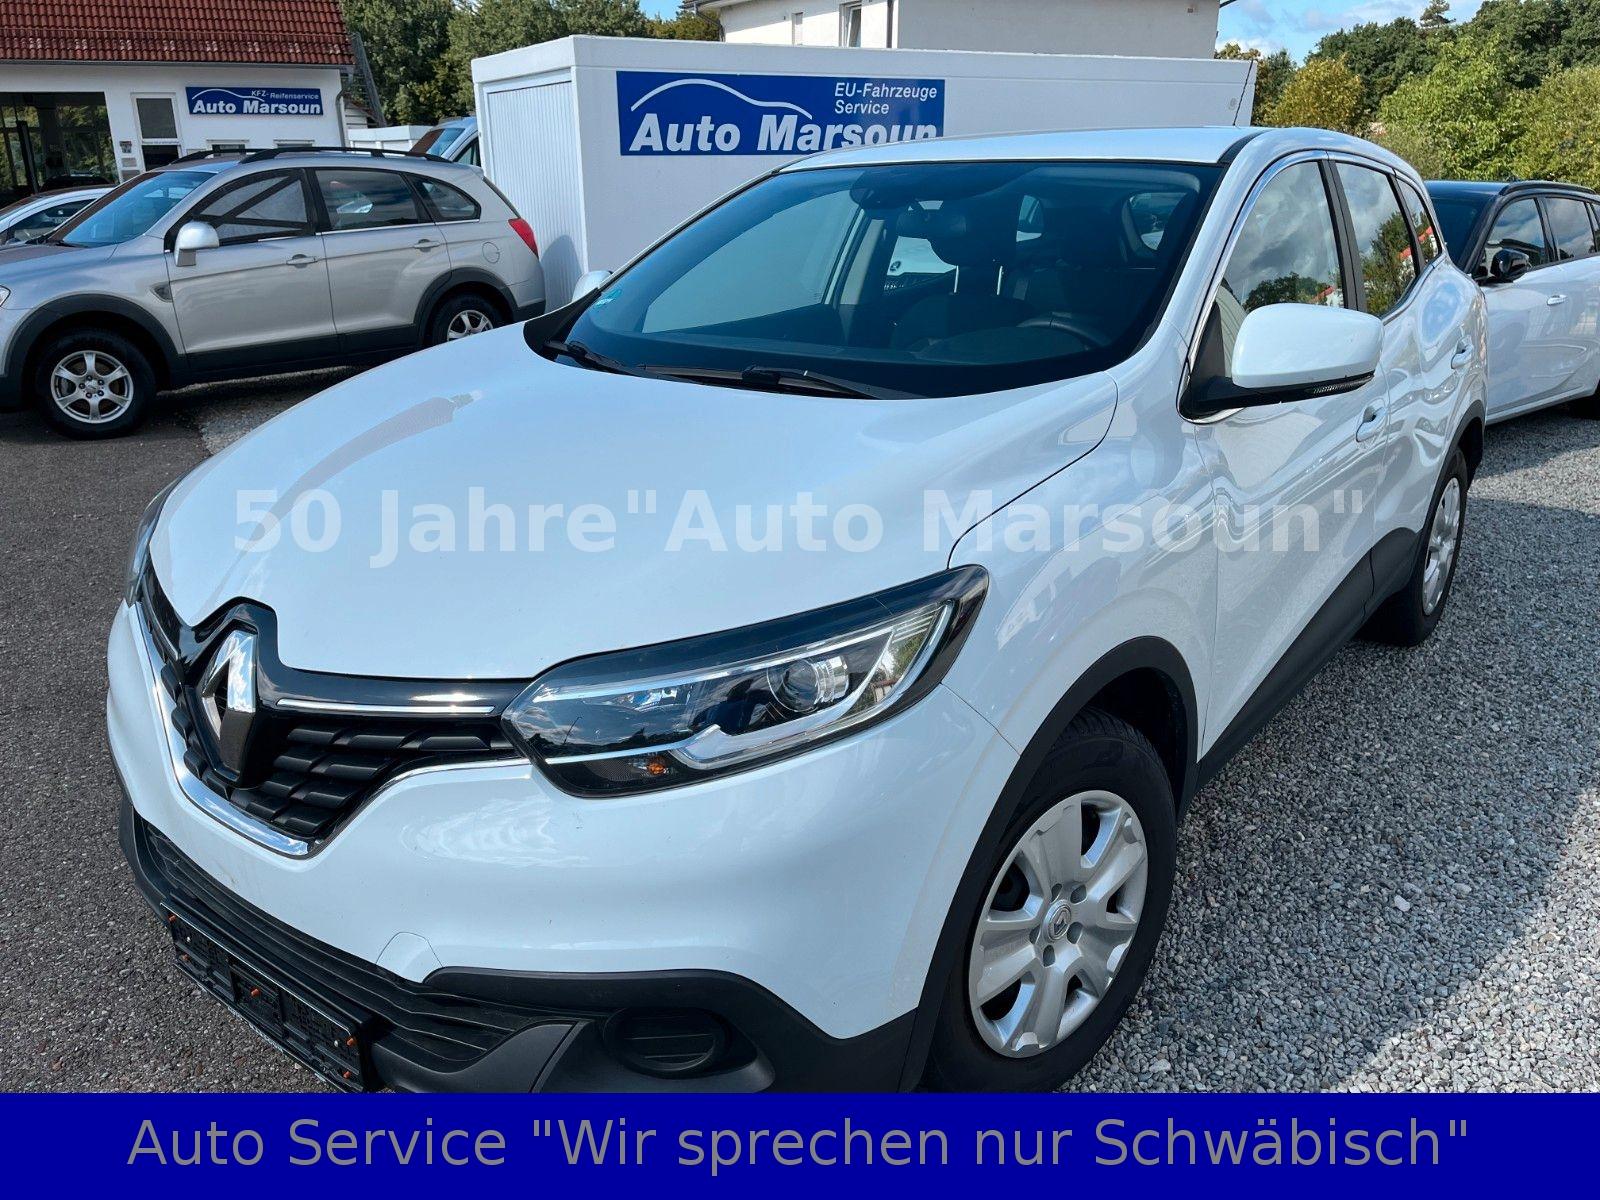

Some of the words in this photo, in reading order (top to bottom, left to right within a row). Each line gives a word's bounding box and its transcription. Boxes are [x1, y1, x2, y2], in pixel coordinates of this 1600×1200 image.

[834, 83, 937, 99] EU-Fahrzeuge
[193, 100, 236, 113] Auto
[243, 100, 320, 114] Marsoun
[834, 99, 889, 115] Service
[629, 113, 740, 151] Auto
